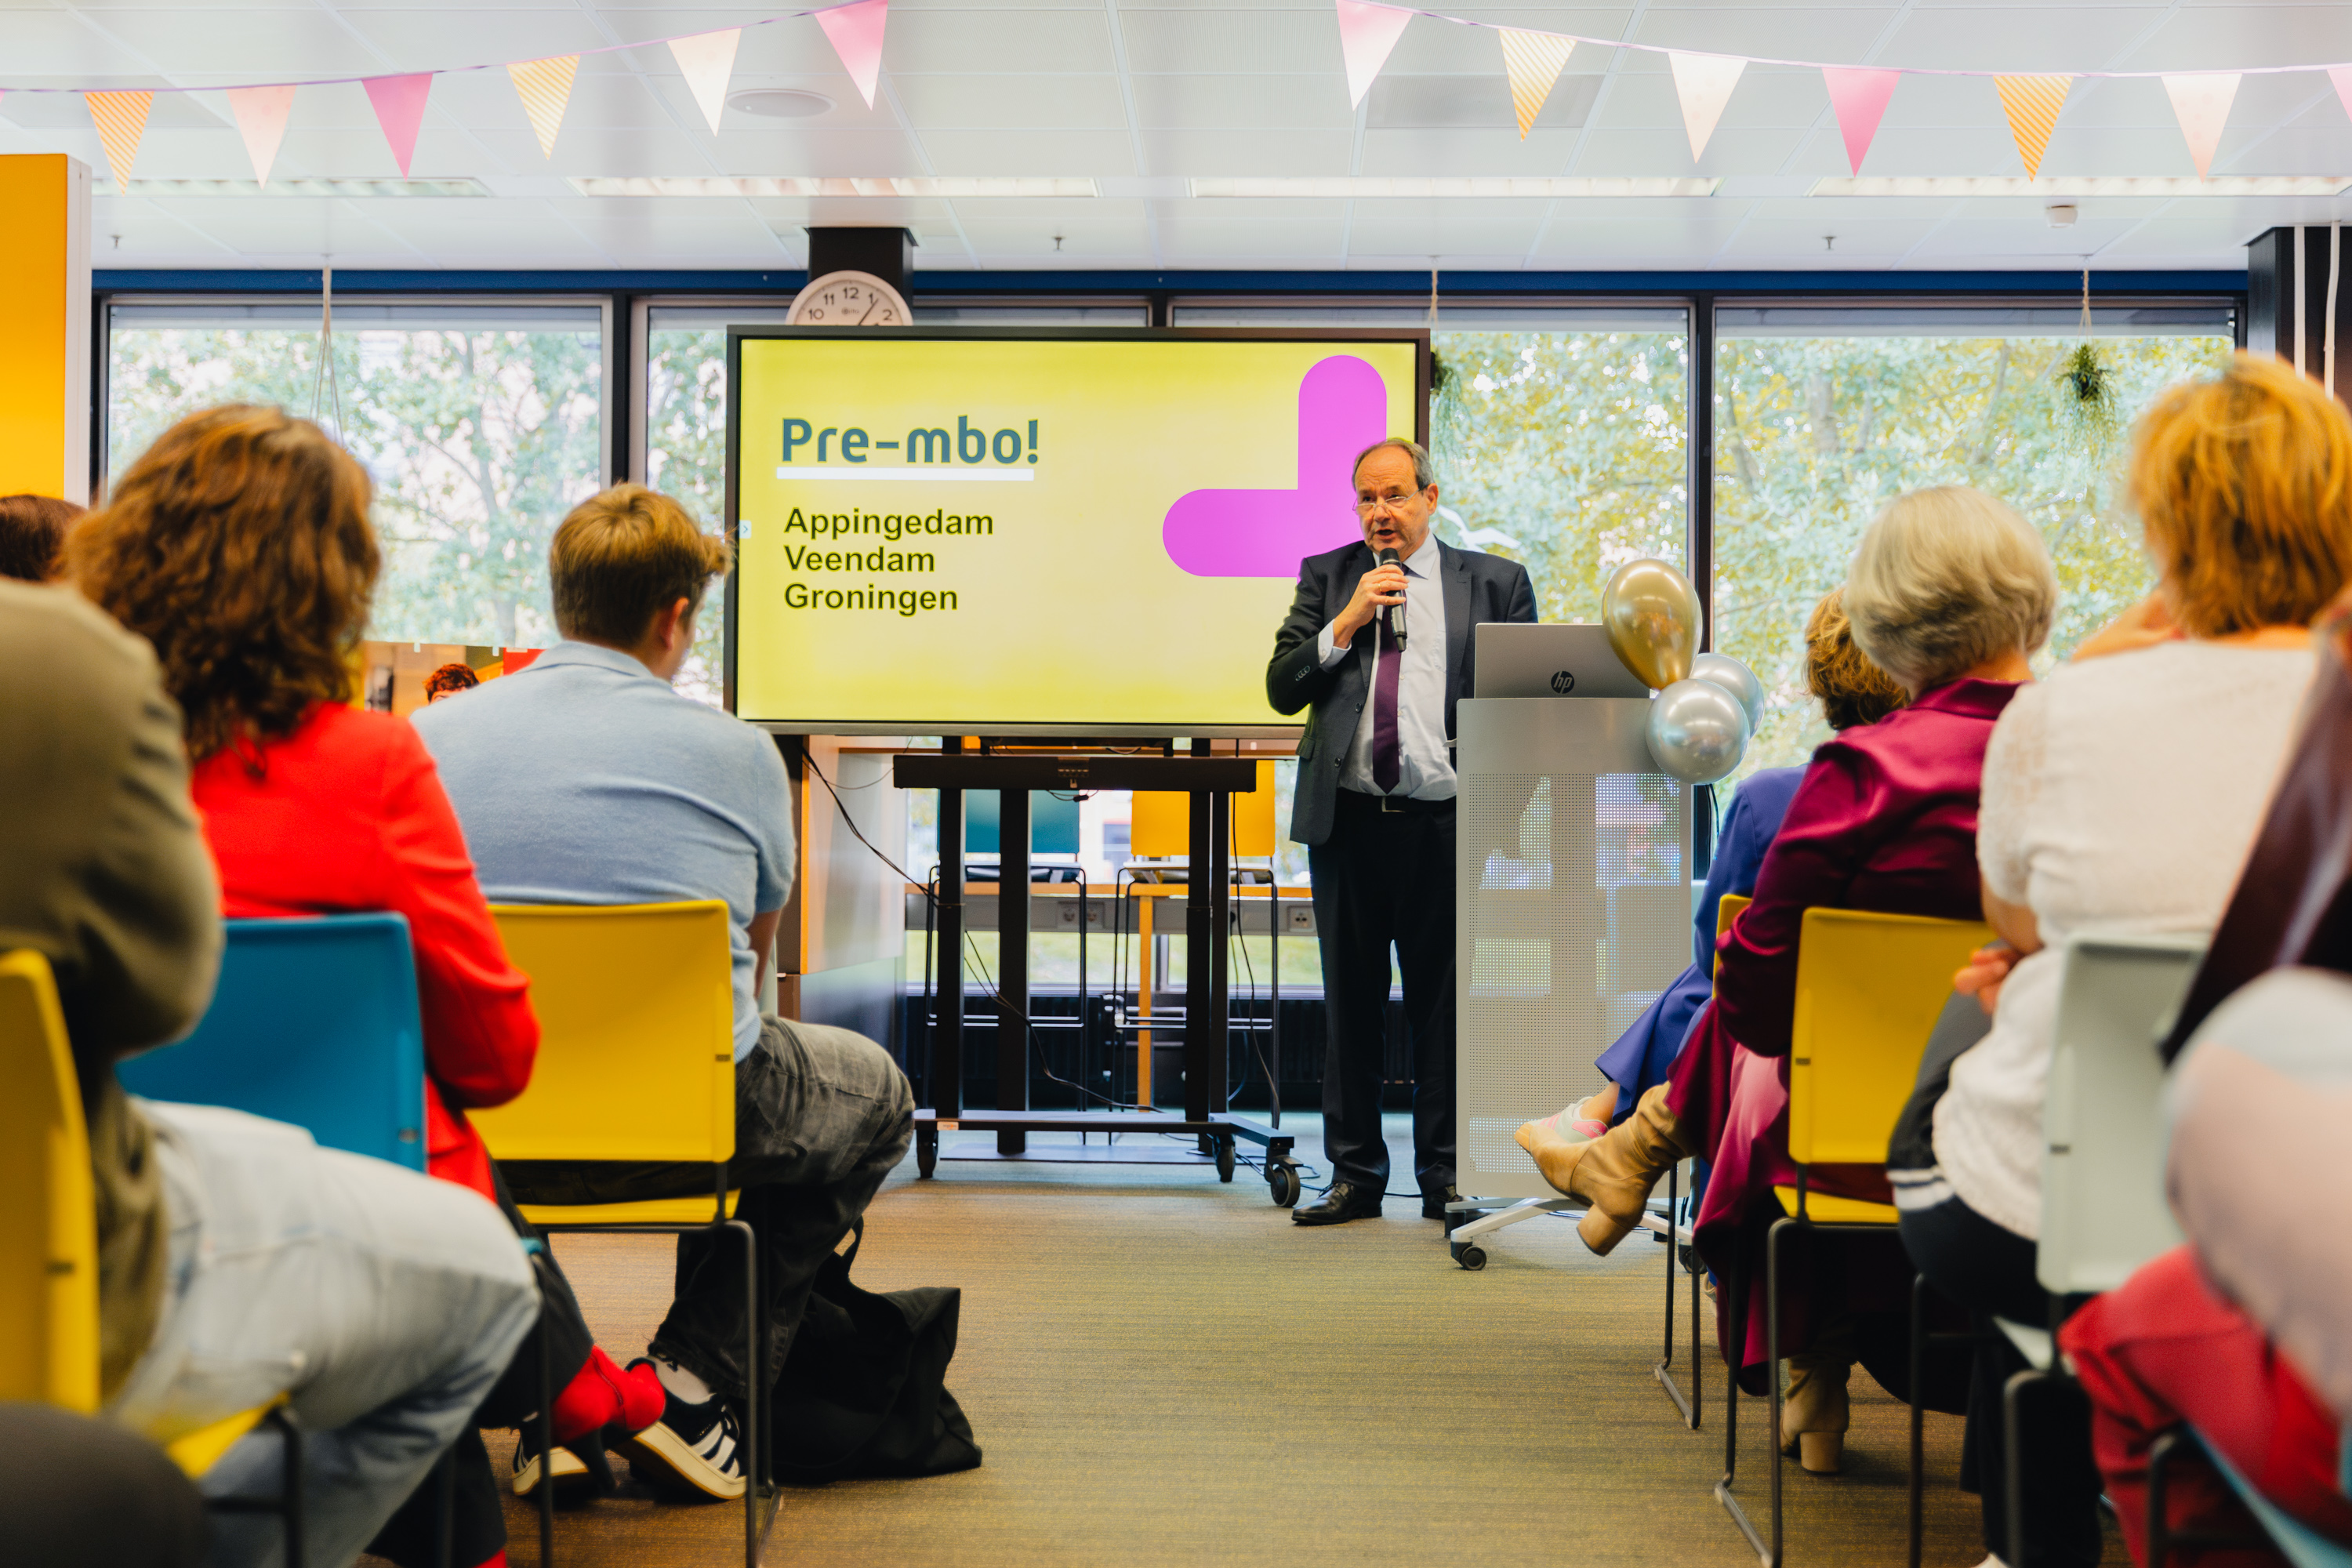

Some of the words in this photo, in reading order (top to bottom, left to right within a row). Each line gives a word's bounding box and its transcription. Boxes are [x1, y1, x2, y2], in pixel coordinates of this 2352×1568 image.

[823, 293, 835, 305] 11
[843, 287, 859, 299] 12
[868, 292, 874, 304] 1
[808, 308, 825, 320] 10
[882, 309, 892, 321] 2
[782, 416, 1038, 464] Pre-mbo!
[784, 508, 993, 541] Appingedam
[784, 546, 935, 572] Veendam
[784, 583, 957, 617] Groningen
[1552, 670, 1573, 695] hp
